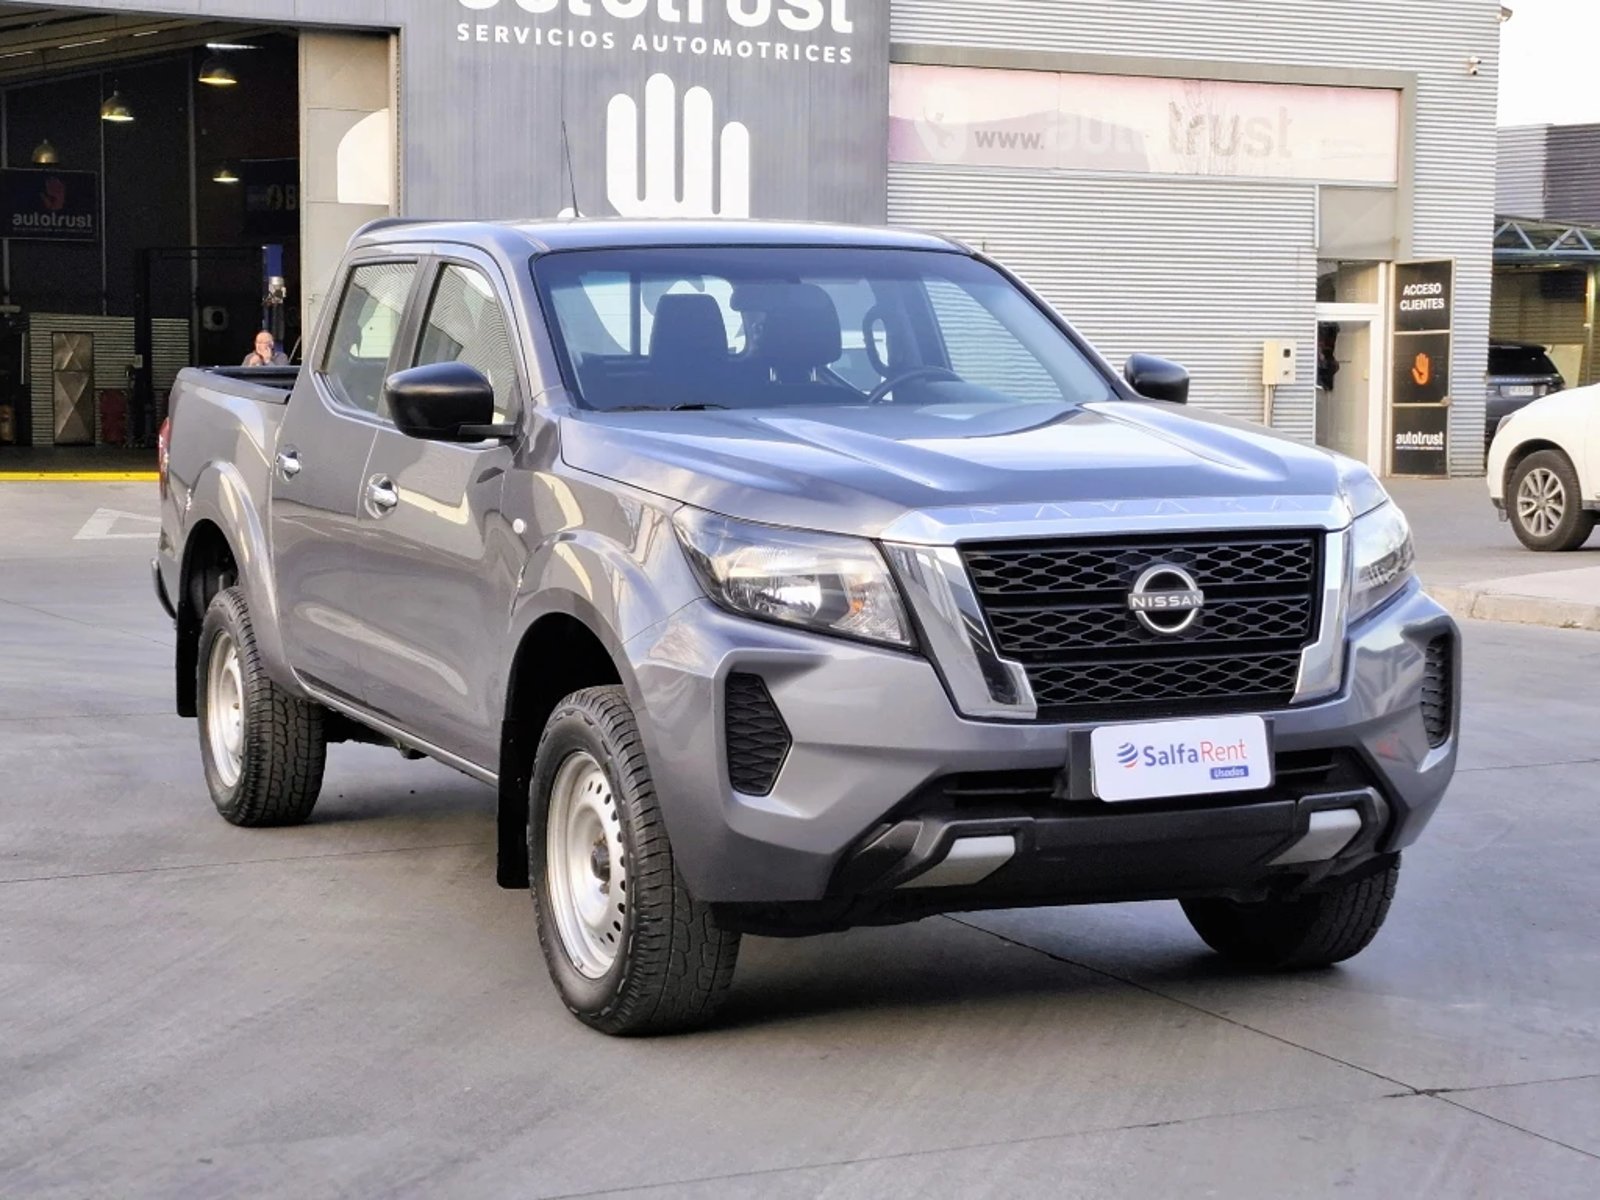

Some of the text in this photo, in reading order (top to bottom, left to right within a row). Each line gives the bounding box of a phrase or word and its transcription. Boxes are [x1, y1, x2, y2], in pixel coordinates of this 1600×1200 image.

[456, 23, 853, 64] SERVICIOS AUTOMOTRICES
[974, 129, 1045, 150] www.
[12, 211, 93, 228] autotrust
[1402, 282, 1442, 296] ACCESO
[1399, 297, 1446, 311] CLIENTES
[1395, 430, 1444, 446] autotrust
[1131, 595, 1203, 608] NISSAN
[1143, 738, 1248, 767] SalfaRent
[1213, 767, 1245, 779] Usados
